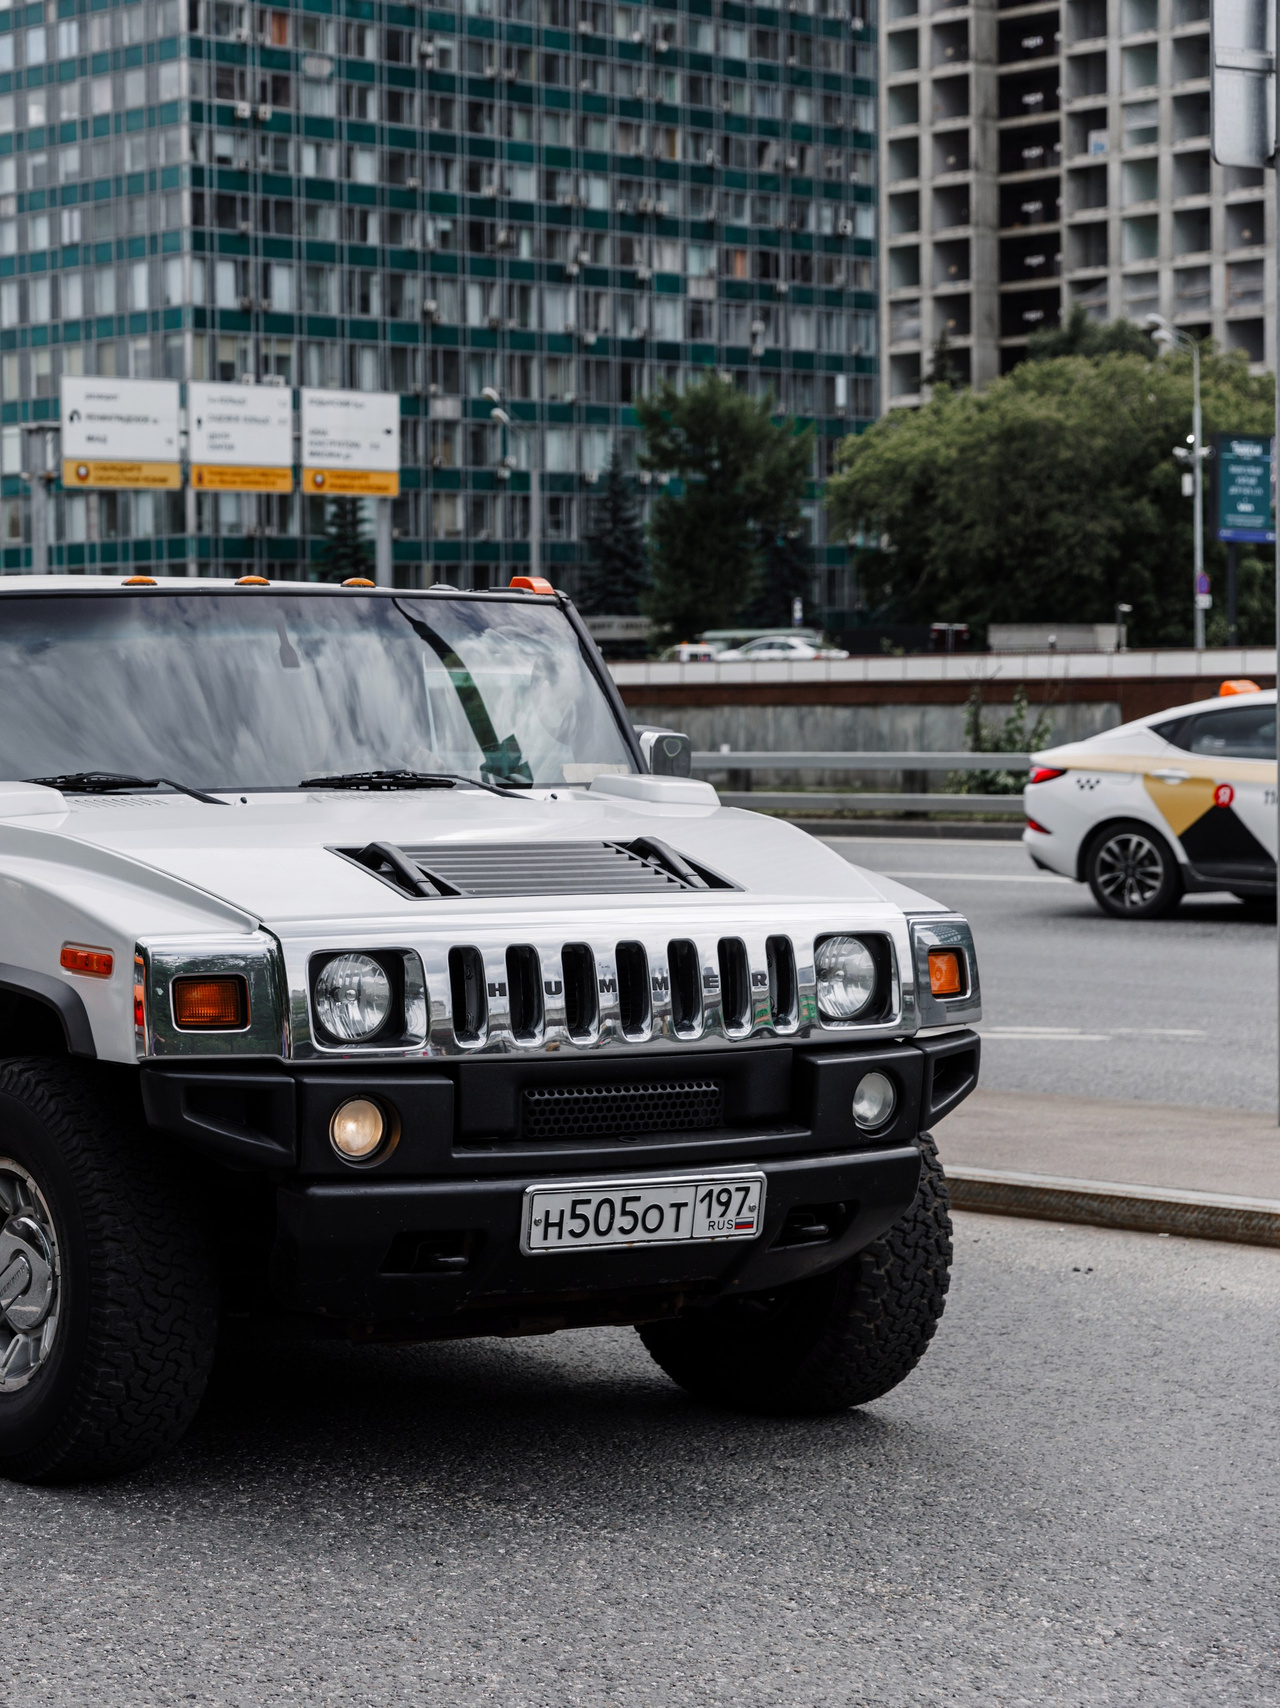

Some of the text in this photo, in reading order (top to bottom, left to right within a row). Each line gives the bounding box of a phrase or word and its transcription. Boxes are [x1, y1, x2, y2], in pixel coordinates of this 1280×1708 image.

[487, 972, 768, 998] HUMMER
[698, 1186, 751, 1219] 197
[707, 1220, 734, 1231] RUS
